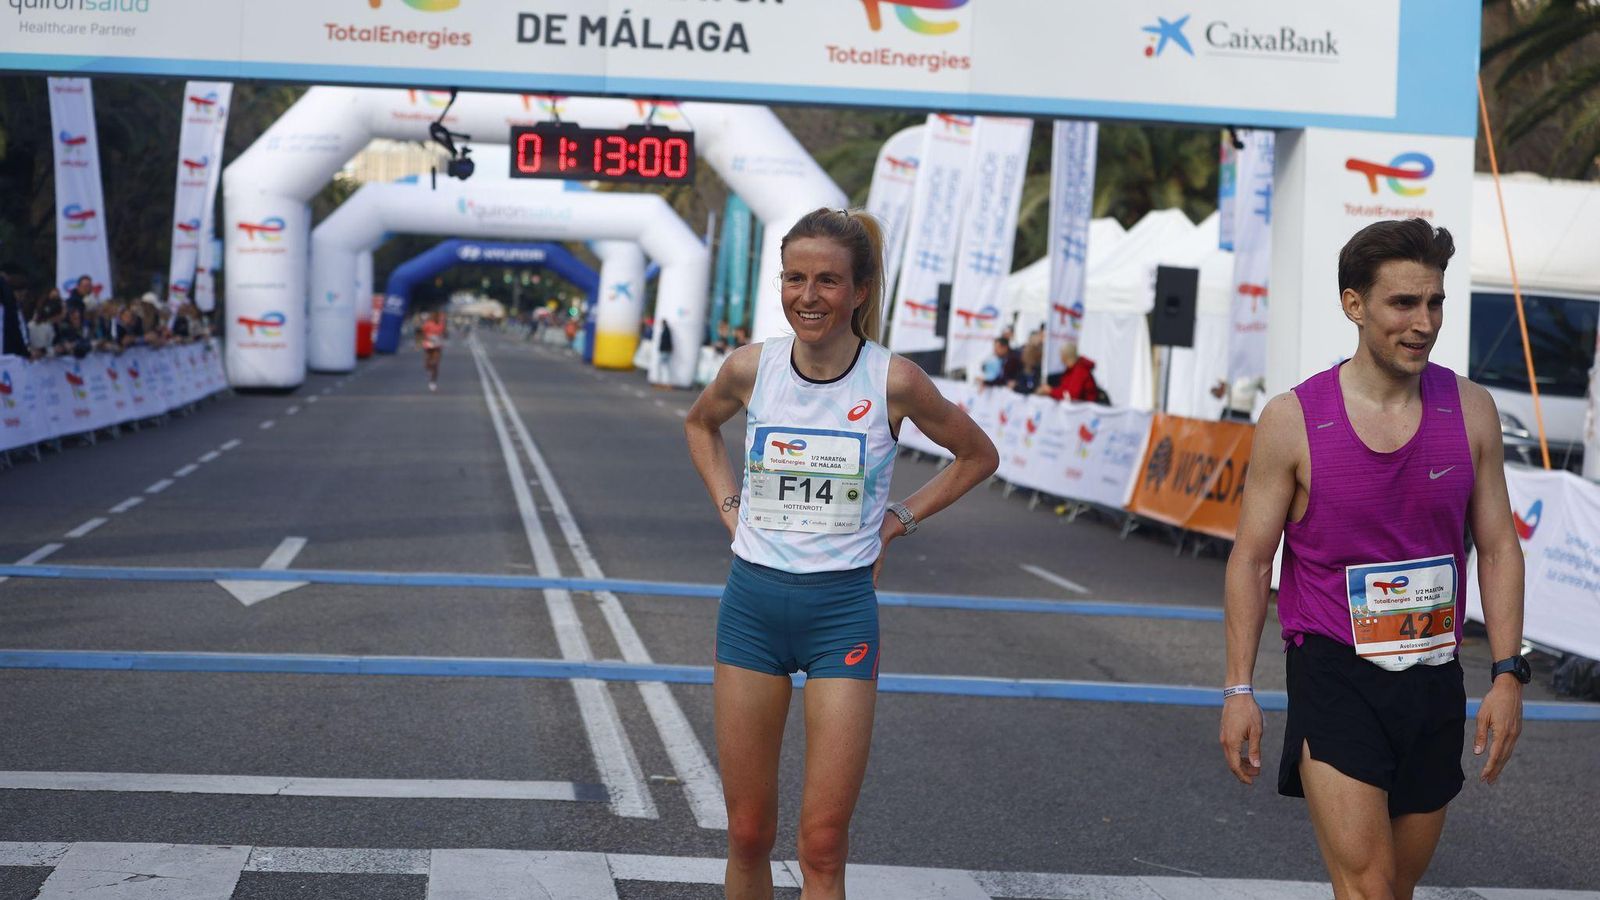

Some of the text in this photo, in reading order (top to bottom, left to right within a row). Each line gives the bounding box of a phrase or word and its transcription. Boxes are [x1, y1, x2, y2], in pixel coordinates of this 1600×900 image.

[19, 20, 137, 37] Healthcare Partner
[325, 22, 472, 50] TotalEnergies
[517, 9, 750, 54] DE MÁLAGA
[1205, 21, 1340, 56] CaixaBank
[825, 45, 972, 73] TotalEnergies
[517, 133, 688, 178] 01:13:00
[1344, 203, 1434, 218] TotalEnergies
[770, 457, 805, 466] TotalEnergies
[779, 475, 833, 505] F14
[783, 504, 823, 512] HOTTENROTT
[1374, 597, 1411, 605] TotalEnergies
[1400, 612, 1434, 640] 42
